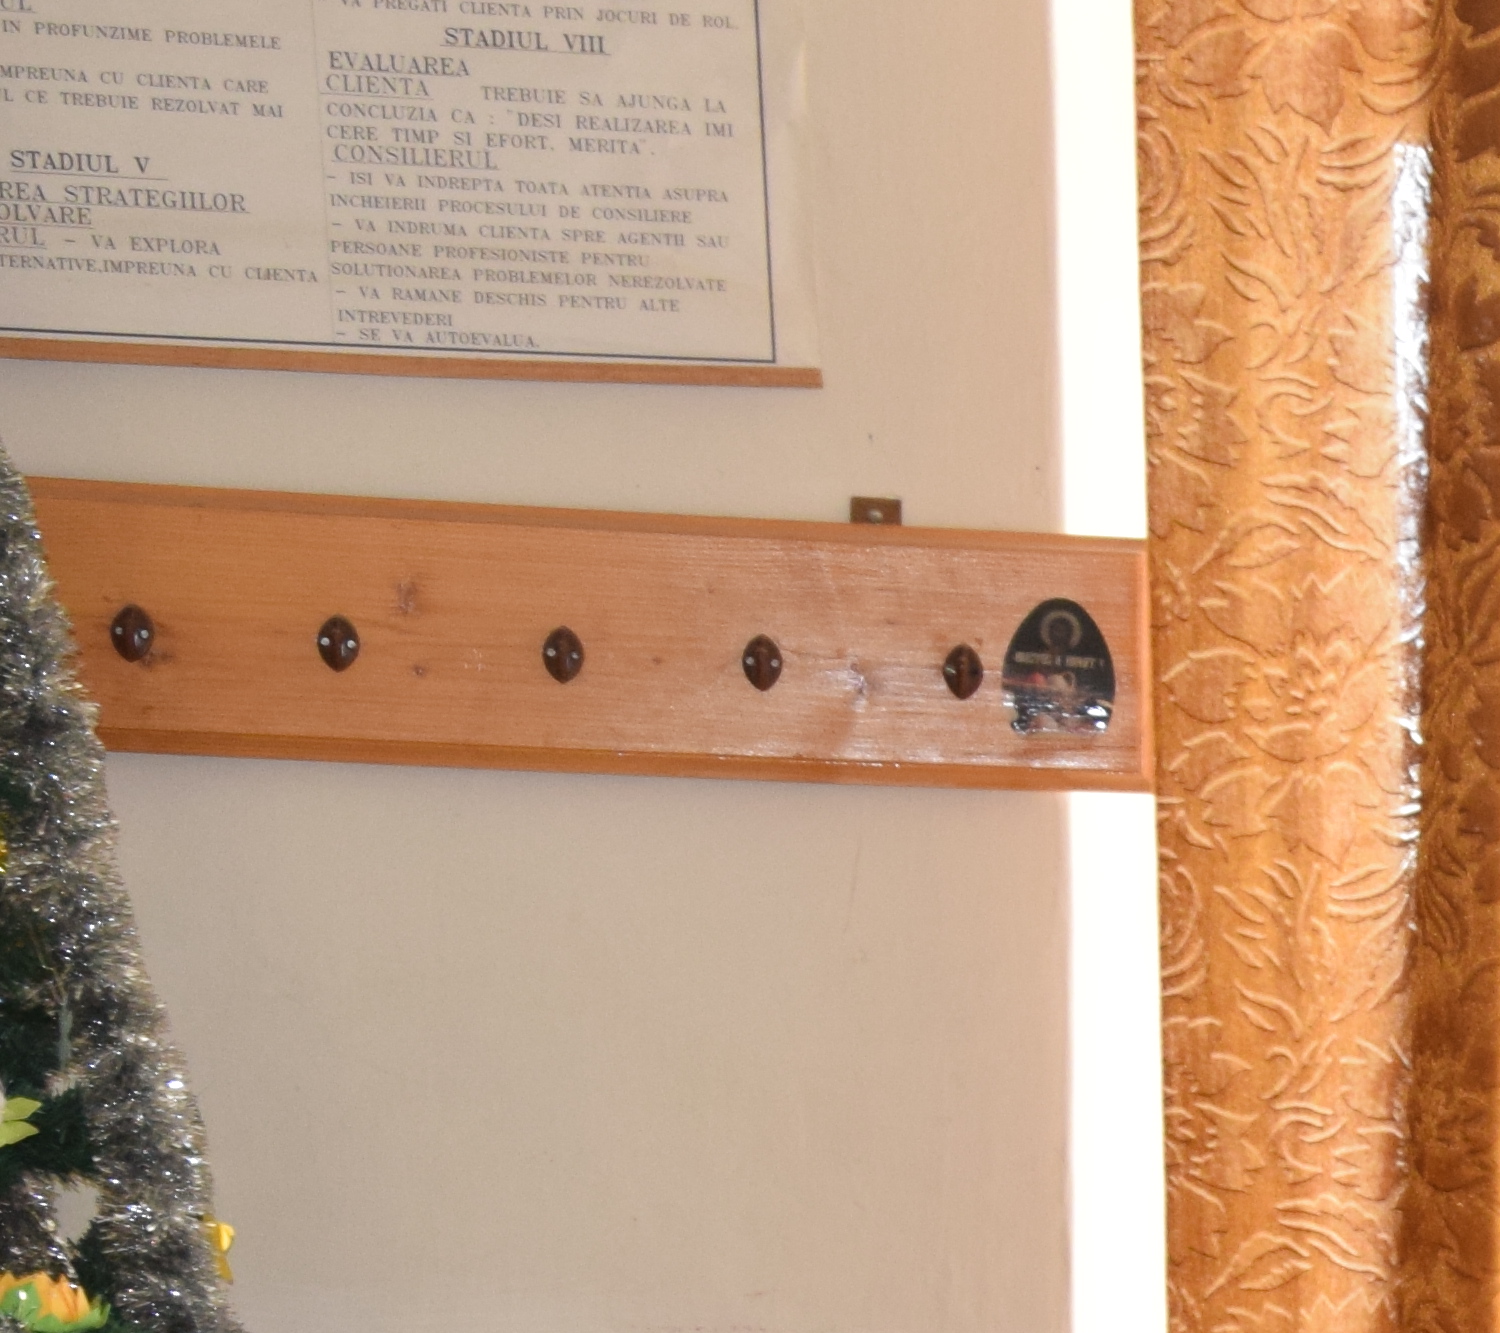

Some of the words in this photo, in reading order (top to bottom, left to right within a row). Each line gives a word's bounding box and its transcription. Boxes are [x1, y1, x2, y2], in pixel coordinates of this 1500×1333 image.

[459, 1, 532, 18] CLIENTA
[543, 6, 584, 21] PRIN
[597, 9, 657, 25] JOCURI
[669, 13, 691, 27] DE
[2, 19, 21, 33] IN
[34, 21, 152, 42] PROFUNZIME
[165, 30, 281, 50] PROBLEMELE
[444, 27, 549, 50] STADIUL
[563, 33, 606, 54] VIII
[328, 51, 470, 76] EVALUAREA
[100, 72, 124, 84] CU
[136, 74, 211, 91] CLIENTA
[224, 79, 269, 94] CARE
[326, 73, 429, 96] CLIENTA
[481, 85, 566, 104] TREBUIE
[579, 91, 603, 107] SA
[617, 94, 692, 112] AJUNGA
[705, 98, 726, 113] LA
[25, 90, 49, 104] CE
[60, 92, 139, 110] TREBUIE
[152, 98, 241, 117] REZOLVAT
[252, 104, 284, 119] MAI
[327, 102, 438, 122] CONCLUZIA
[451, 109, 475, 124] CA
[576, 114, 692, 136] REALIZAREA
[705, 122, 733, 138] IMI
[327, 125, 378, 141] CERE
[392, 127, 439, 144] TIMP
[454, 131, 472, 146] SI
[11, 151, 119, 174] STADIUL
[135, 157, 151, 174] V
[335, 144, 498, 169] CONSILIERUL
[64, 185, 246, 212] STRATEGIILOR
[350, 172, 373, 186] ISI
[385, 173, 406, 187] VA
[418, 175, 504, 192] INDREPTA
[515, 180, 569, 196] TOATA
[582, 184, 652, 200] ATENTIA
[662, 188, 728, 203] ASUPRA
[330, 193, 426, 211] INCHEIERII
[438, 199, 546, 217] PROCESULUI
[559, 205, 580, 219] DE
[592, 207, 692, 223] CONSILIERE
[91, 234, 117, 251] VA
[130, 236, 221, 255] EXPLORA
[355, 218, 376, 232] VA
[388, 219, 468, 237] INDRUMA
[479, 225, 550, 241] CLIENTA
[562, 228, 606, 243] SPRE
[697, 235, 728, 249] SAU
[330, 240, 422, 258] PERSOANE
[434, 245, 569, 264] PROFESIONISTE
[581, 251, 650, 268] PENTRU
[209, 265, 233, 279] CU
[244, 267, 318, 283] CLIENTA
[330, 262, 461, 281] SOLUTIONAREA
[473, 268, 597, 287] PROBLEMELOR
[608, 274, 727, 292] NEREZOLVATE
[359, 286, 380, 300] VA
[392, 287, 462, 304] RAMANE
[474, 291, 547, 307] DESCHIS
[558, 294, 627, 311] PENTRU
[640, 299, 680, 312] ALTE
[338, 309, 453, 327] INTREVEDERI
[359, 328, 380, 341] SE
[392, 329, 414, 344] VA
